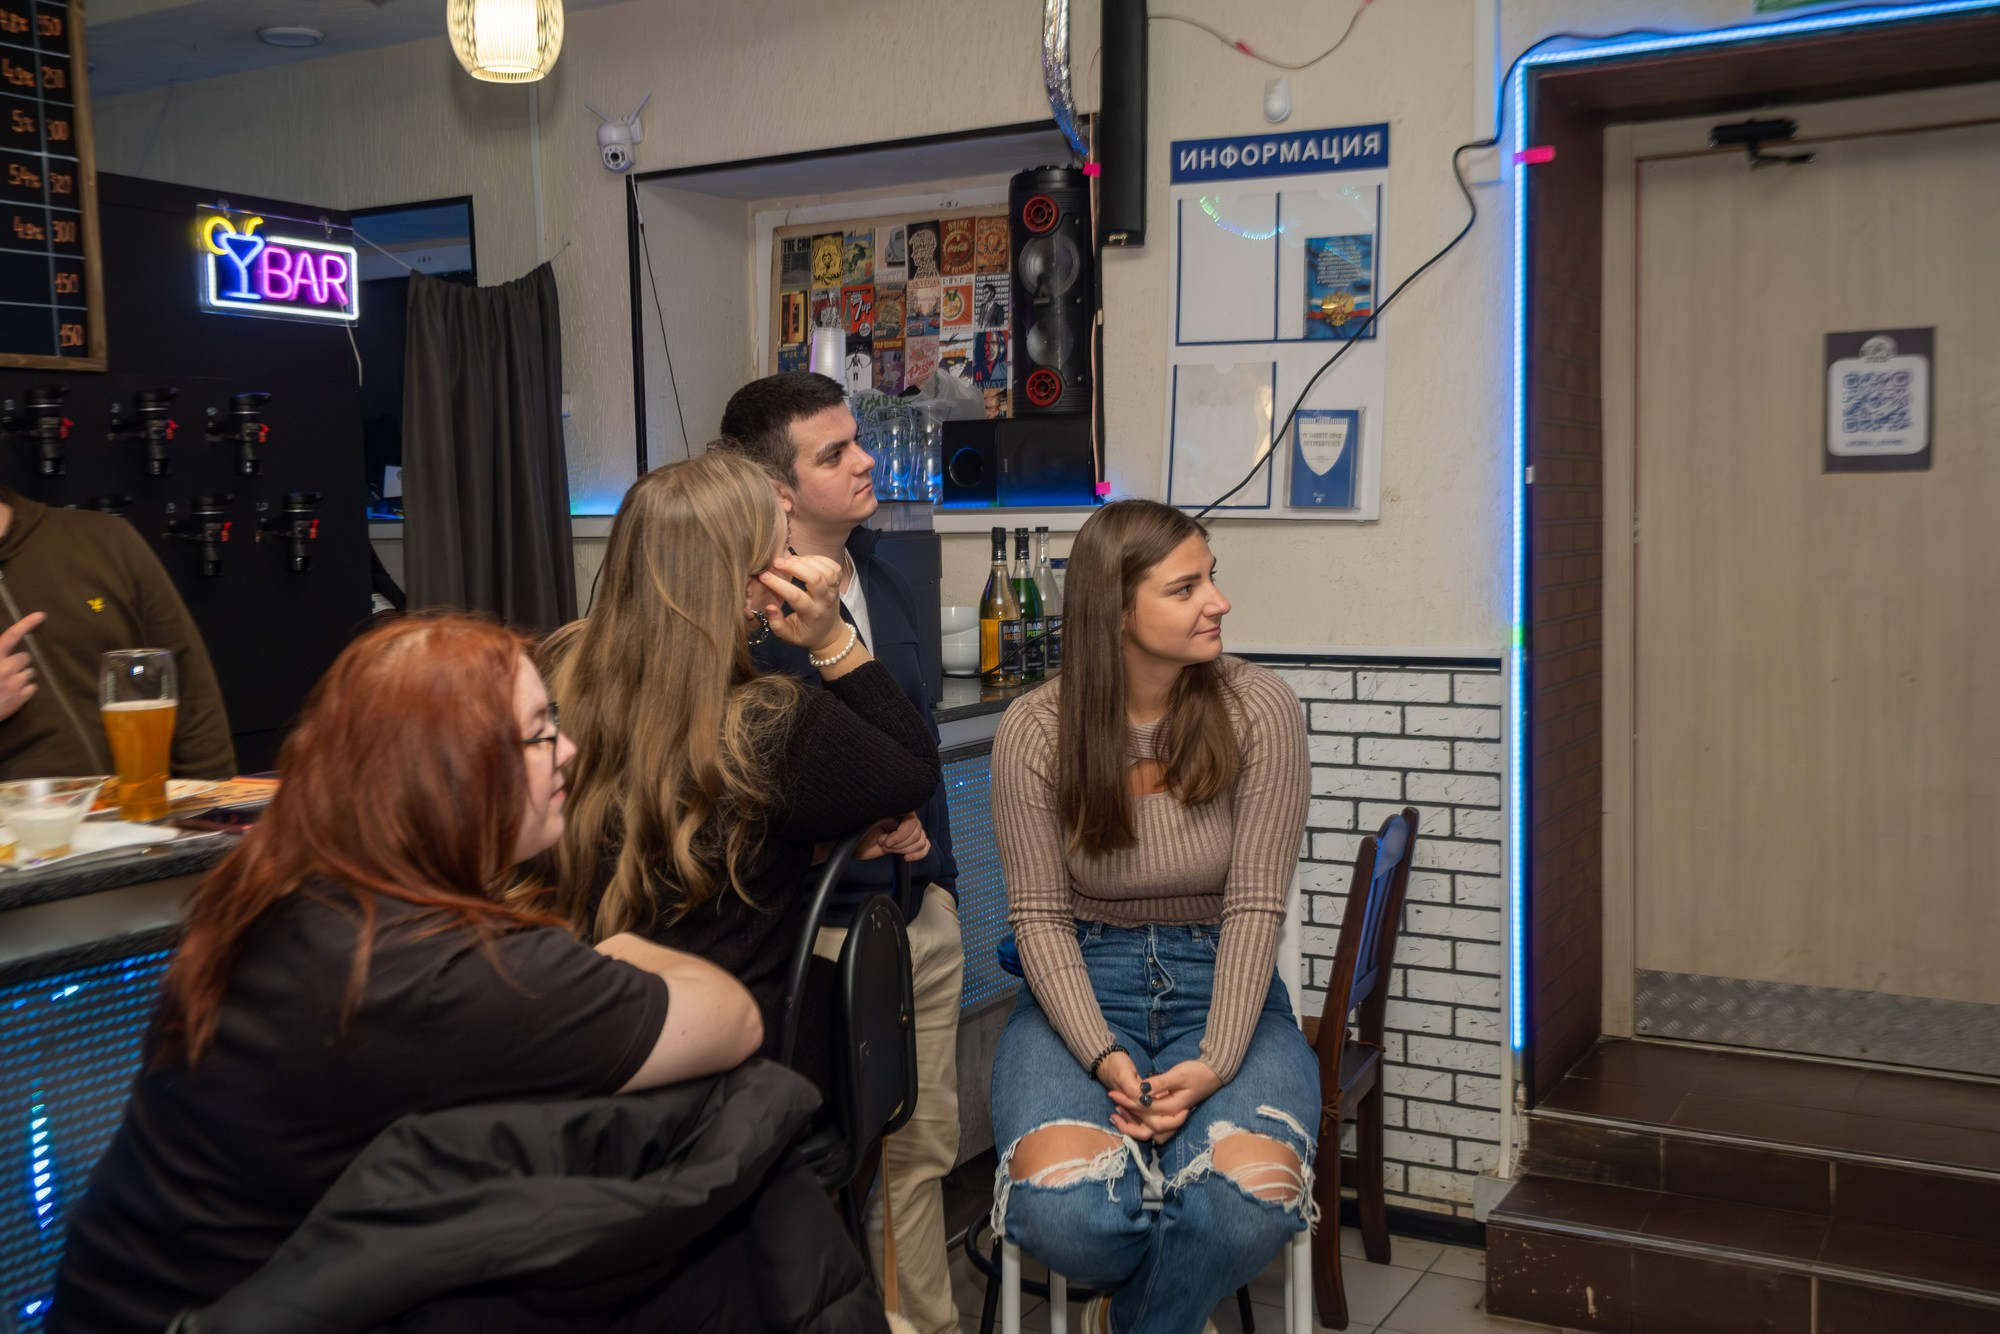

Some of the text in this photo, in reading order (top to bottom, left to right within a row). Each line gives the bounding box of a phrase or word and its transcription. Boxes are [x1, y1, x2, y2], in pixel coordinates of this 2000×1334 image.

[1180, 131, 1380, 171] ИНФОРМАЦИЯ
[783, 239, 796, 254] THE
[262, 246, 349, 306] BAR
